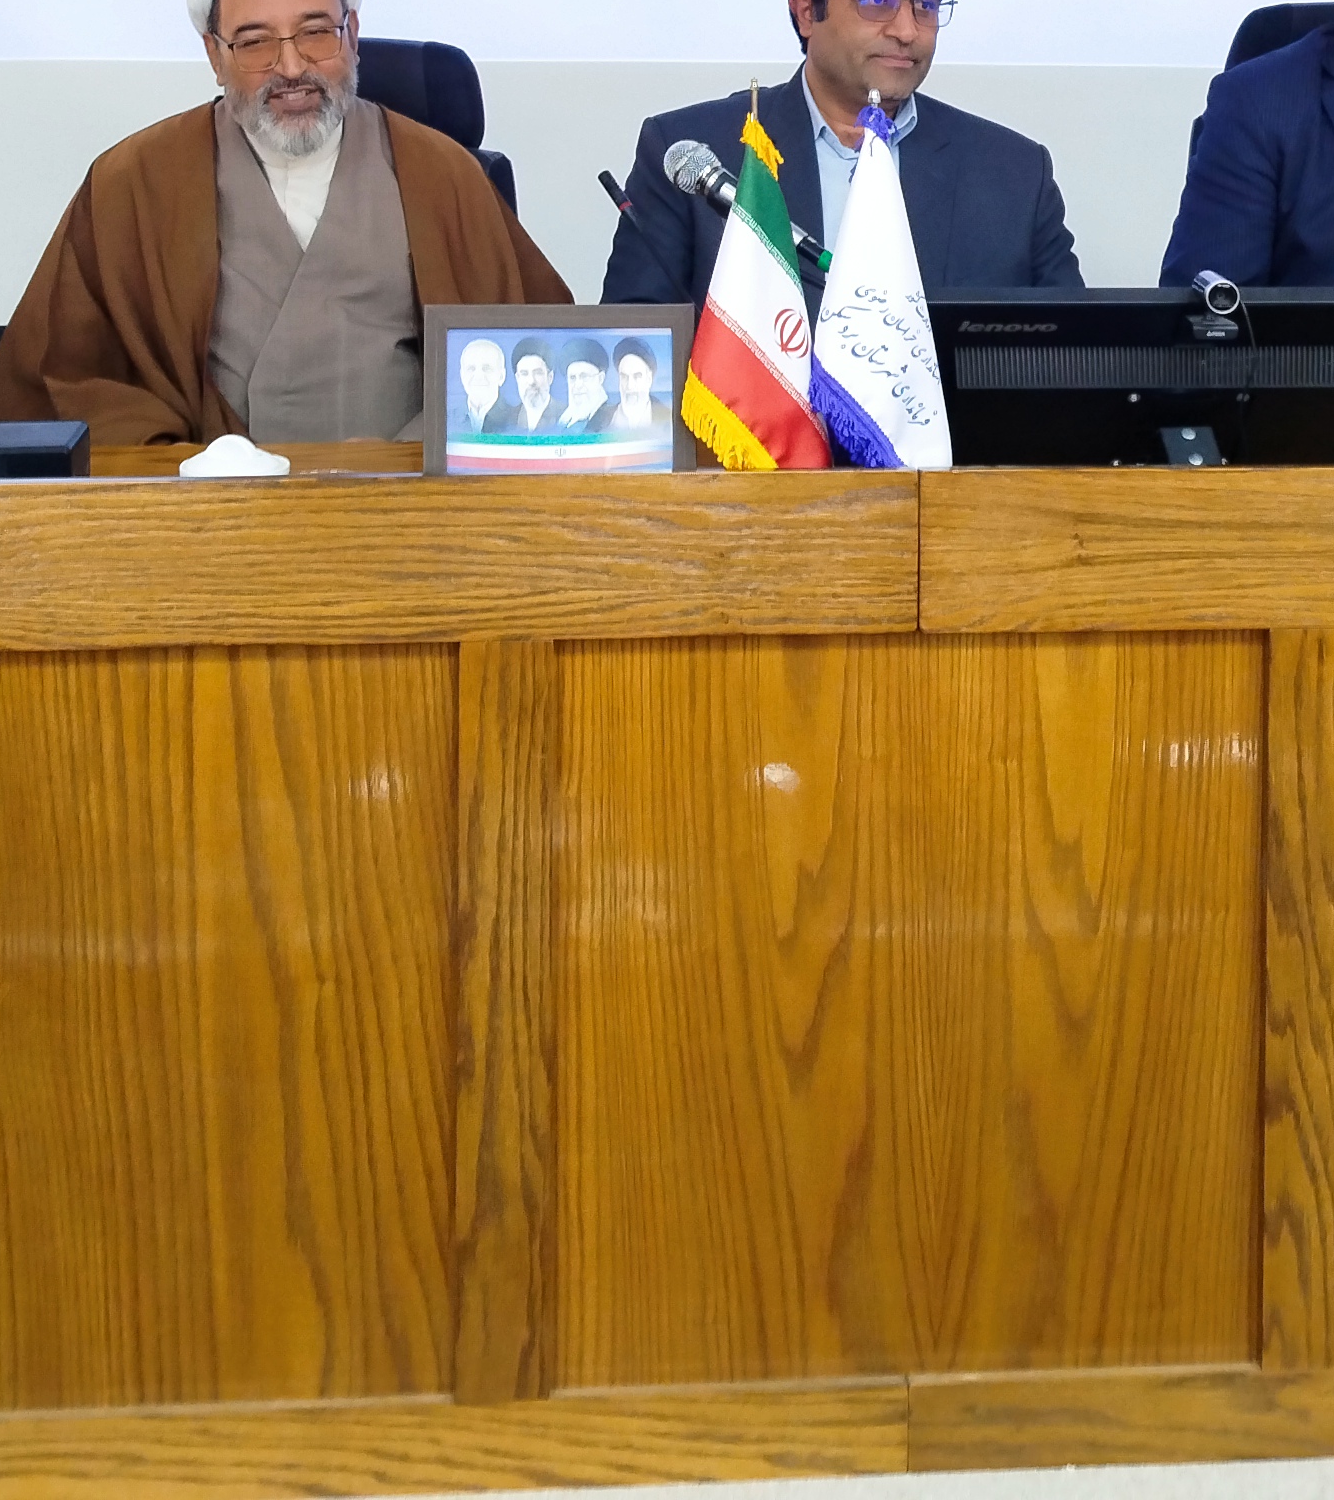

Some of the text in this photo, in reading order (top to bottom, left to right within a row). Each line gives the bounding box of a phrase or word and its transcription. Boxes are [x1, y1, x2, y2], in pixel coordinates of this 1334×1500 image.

[958, 321, 1058, 333] lenovo
[820, 306, 938, 426] فرمانداری شهرستان بردسکن
